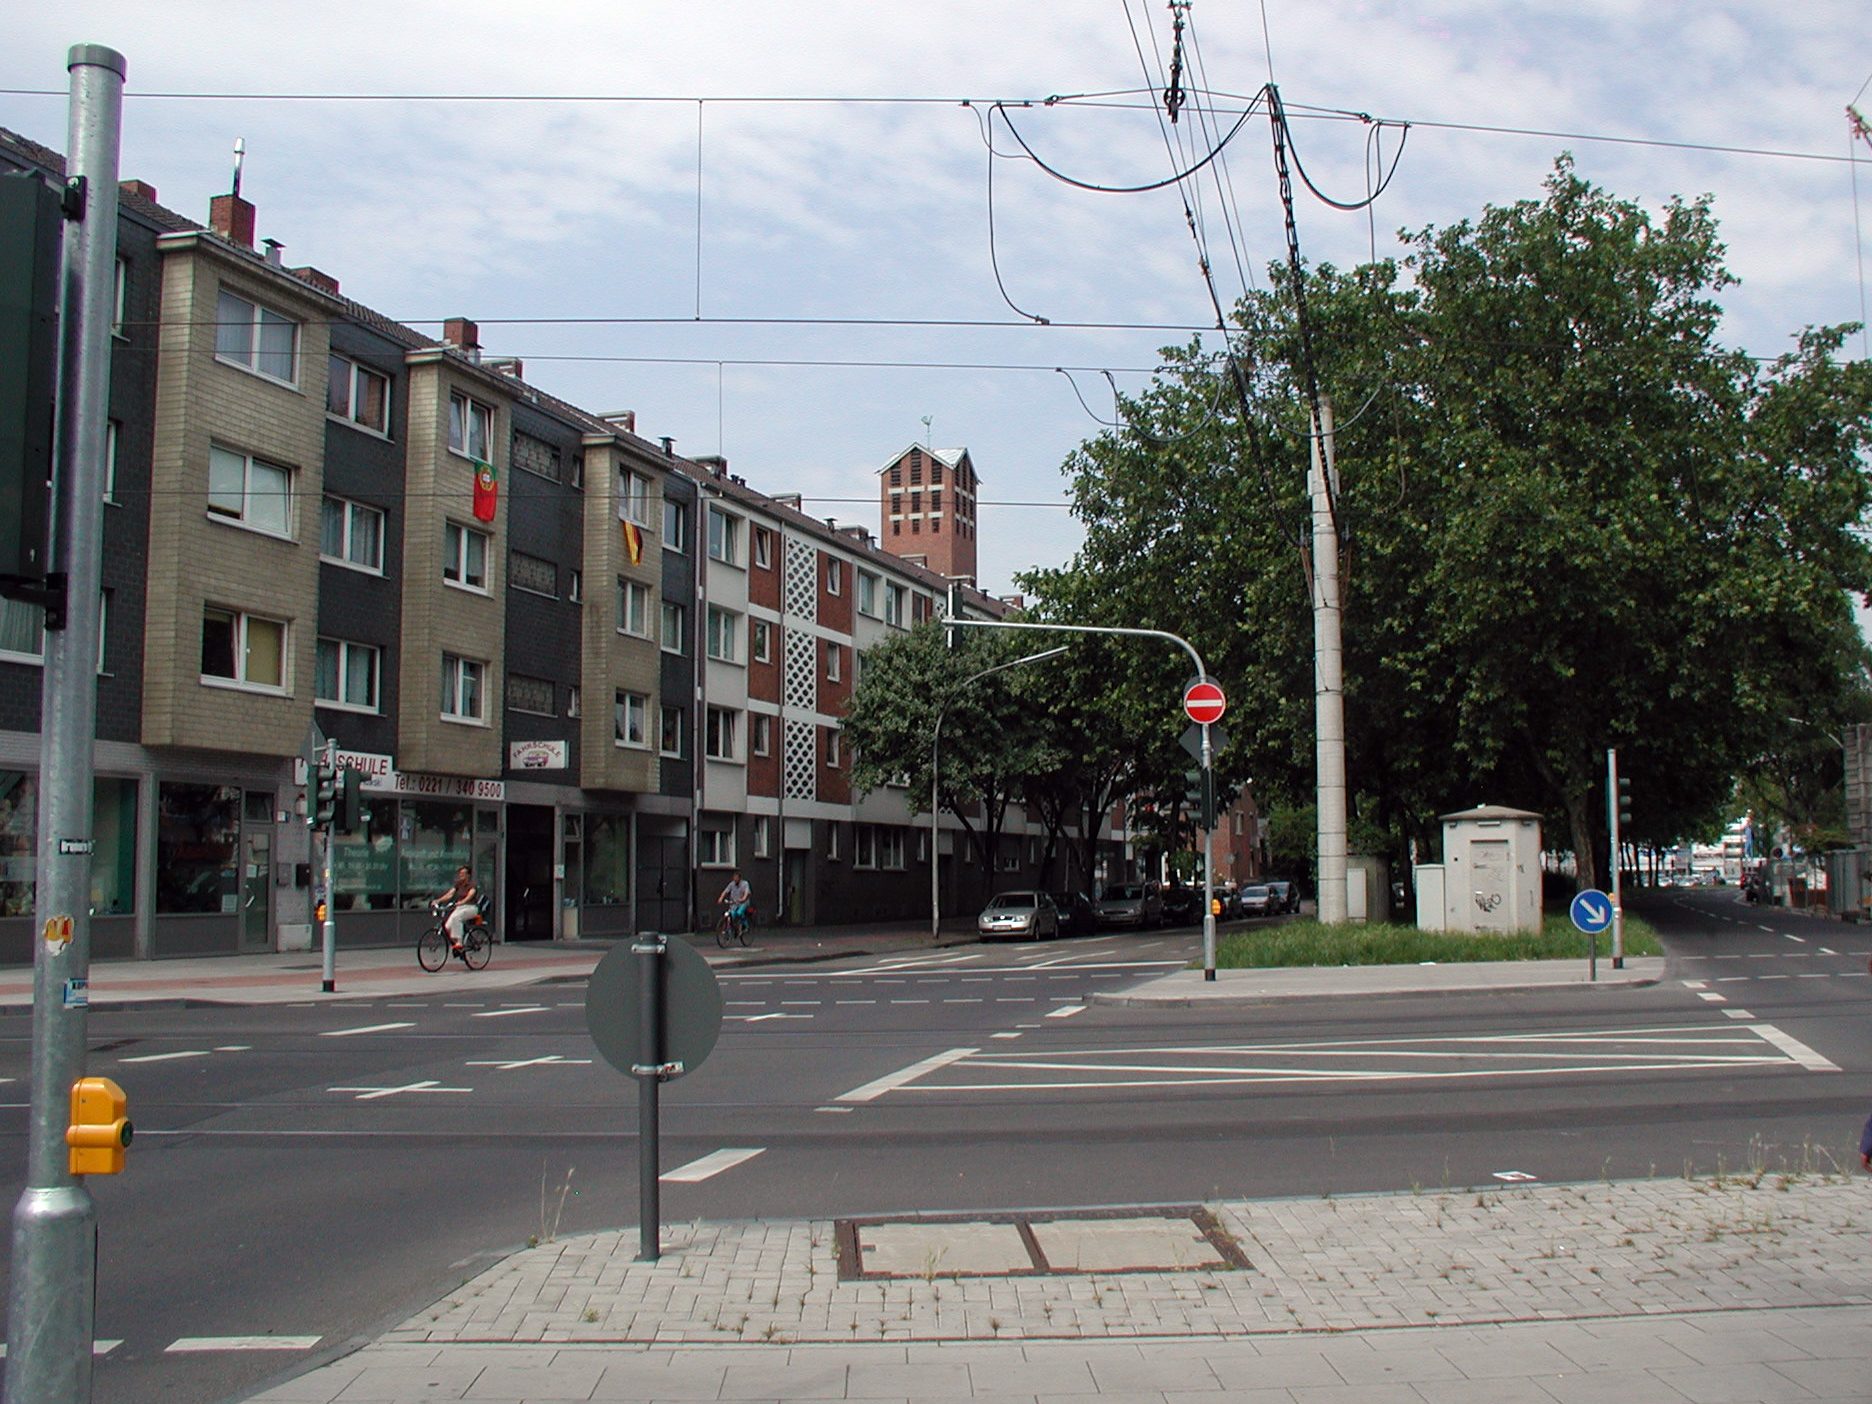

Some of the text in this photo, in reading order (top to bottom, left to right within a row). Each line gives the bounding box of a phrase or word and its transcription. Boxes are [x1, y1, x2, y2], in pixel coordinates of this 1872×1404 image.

[394, 774, 415, 791] Tel.:
[419, 776, 442, 793] 0221
[456, 779, 475, 796] 340
[478, 782, 502, 797] 9500
